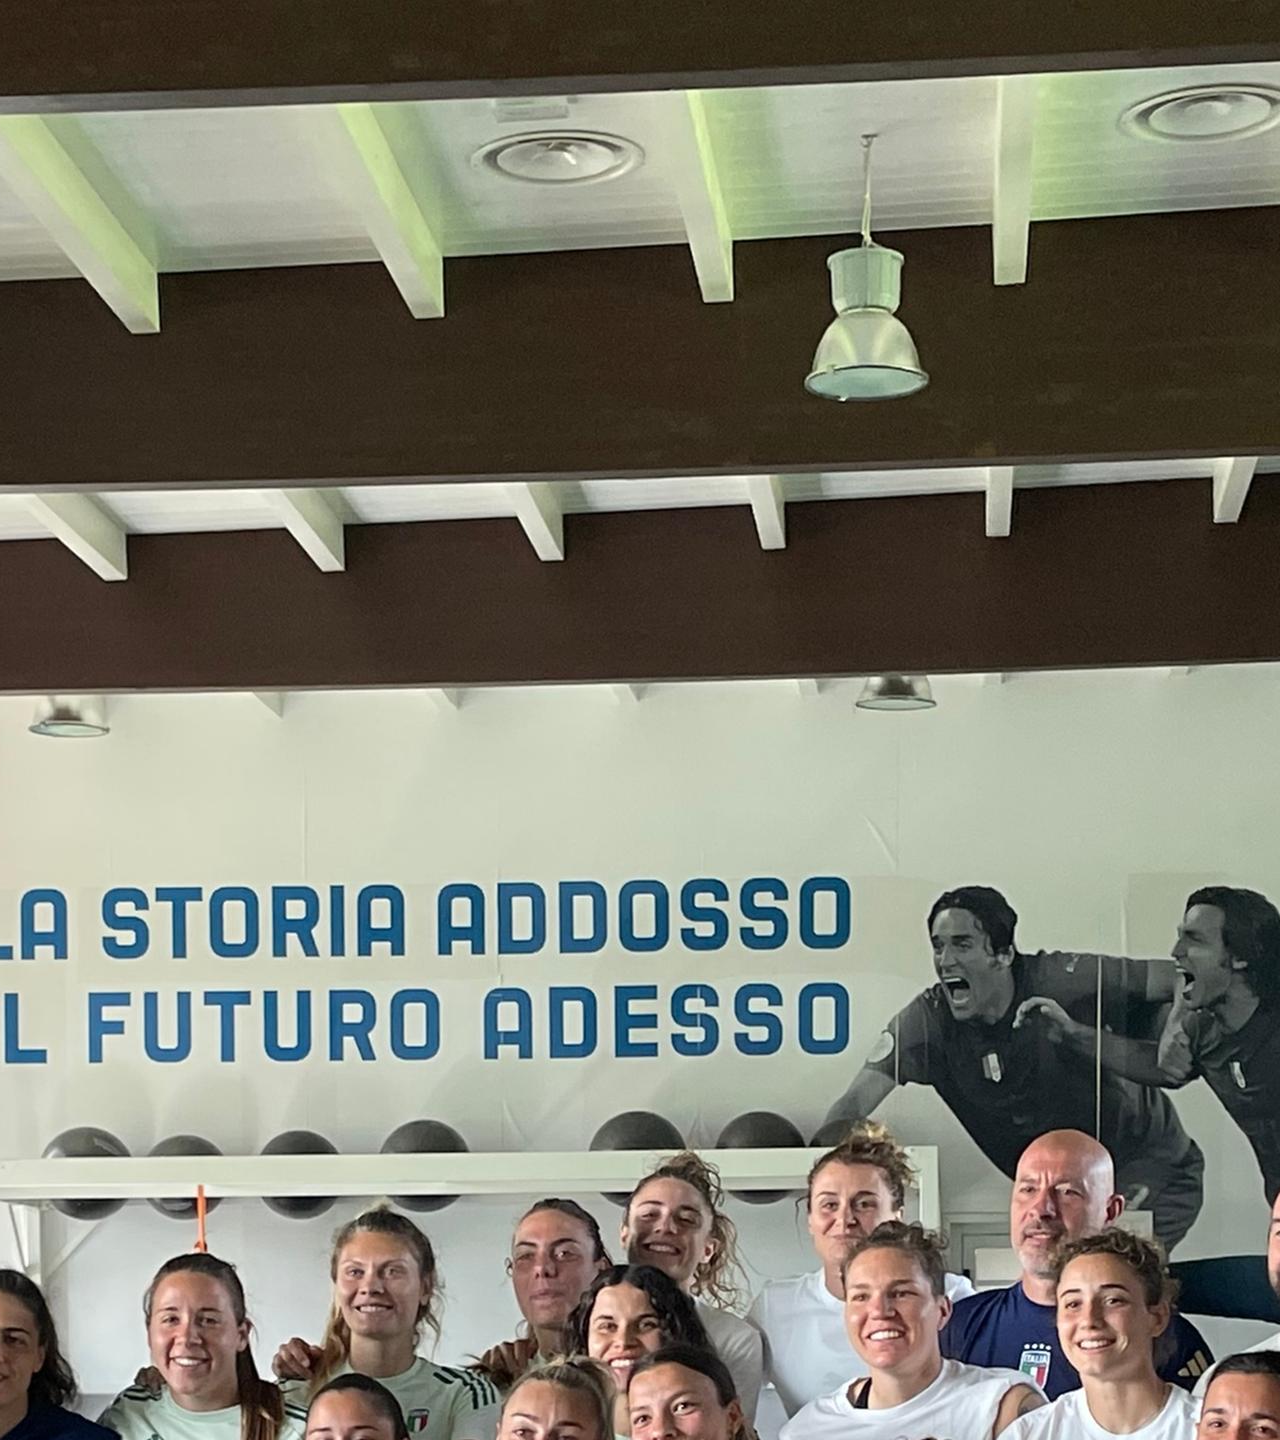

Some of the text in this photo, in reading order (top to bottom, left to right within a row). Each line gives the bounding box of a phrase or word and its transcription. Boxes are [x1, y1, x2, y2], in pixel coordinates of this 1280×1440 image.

[102, 884, 405, 959] STORIA
[437, 876, 851, 956] ADDOSSO
[87, 988, 440, 1063] FUTURO
[483, 982, 850, 1058] ADESSO
